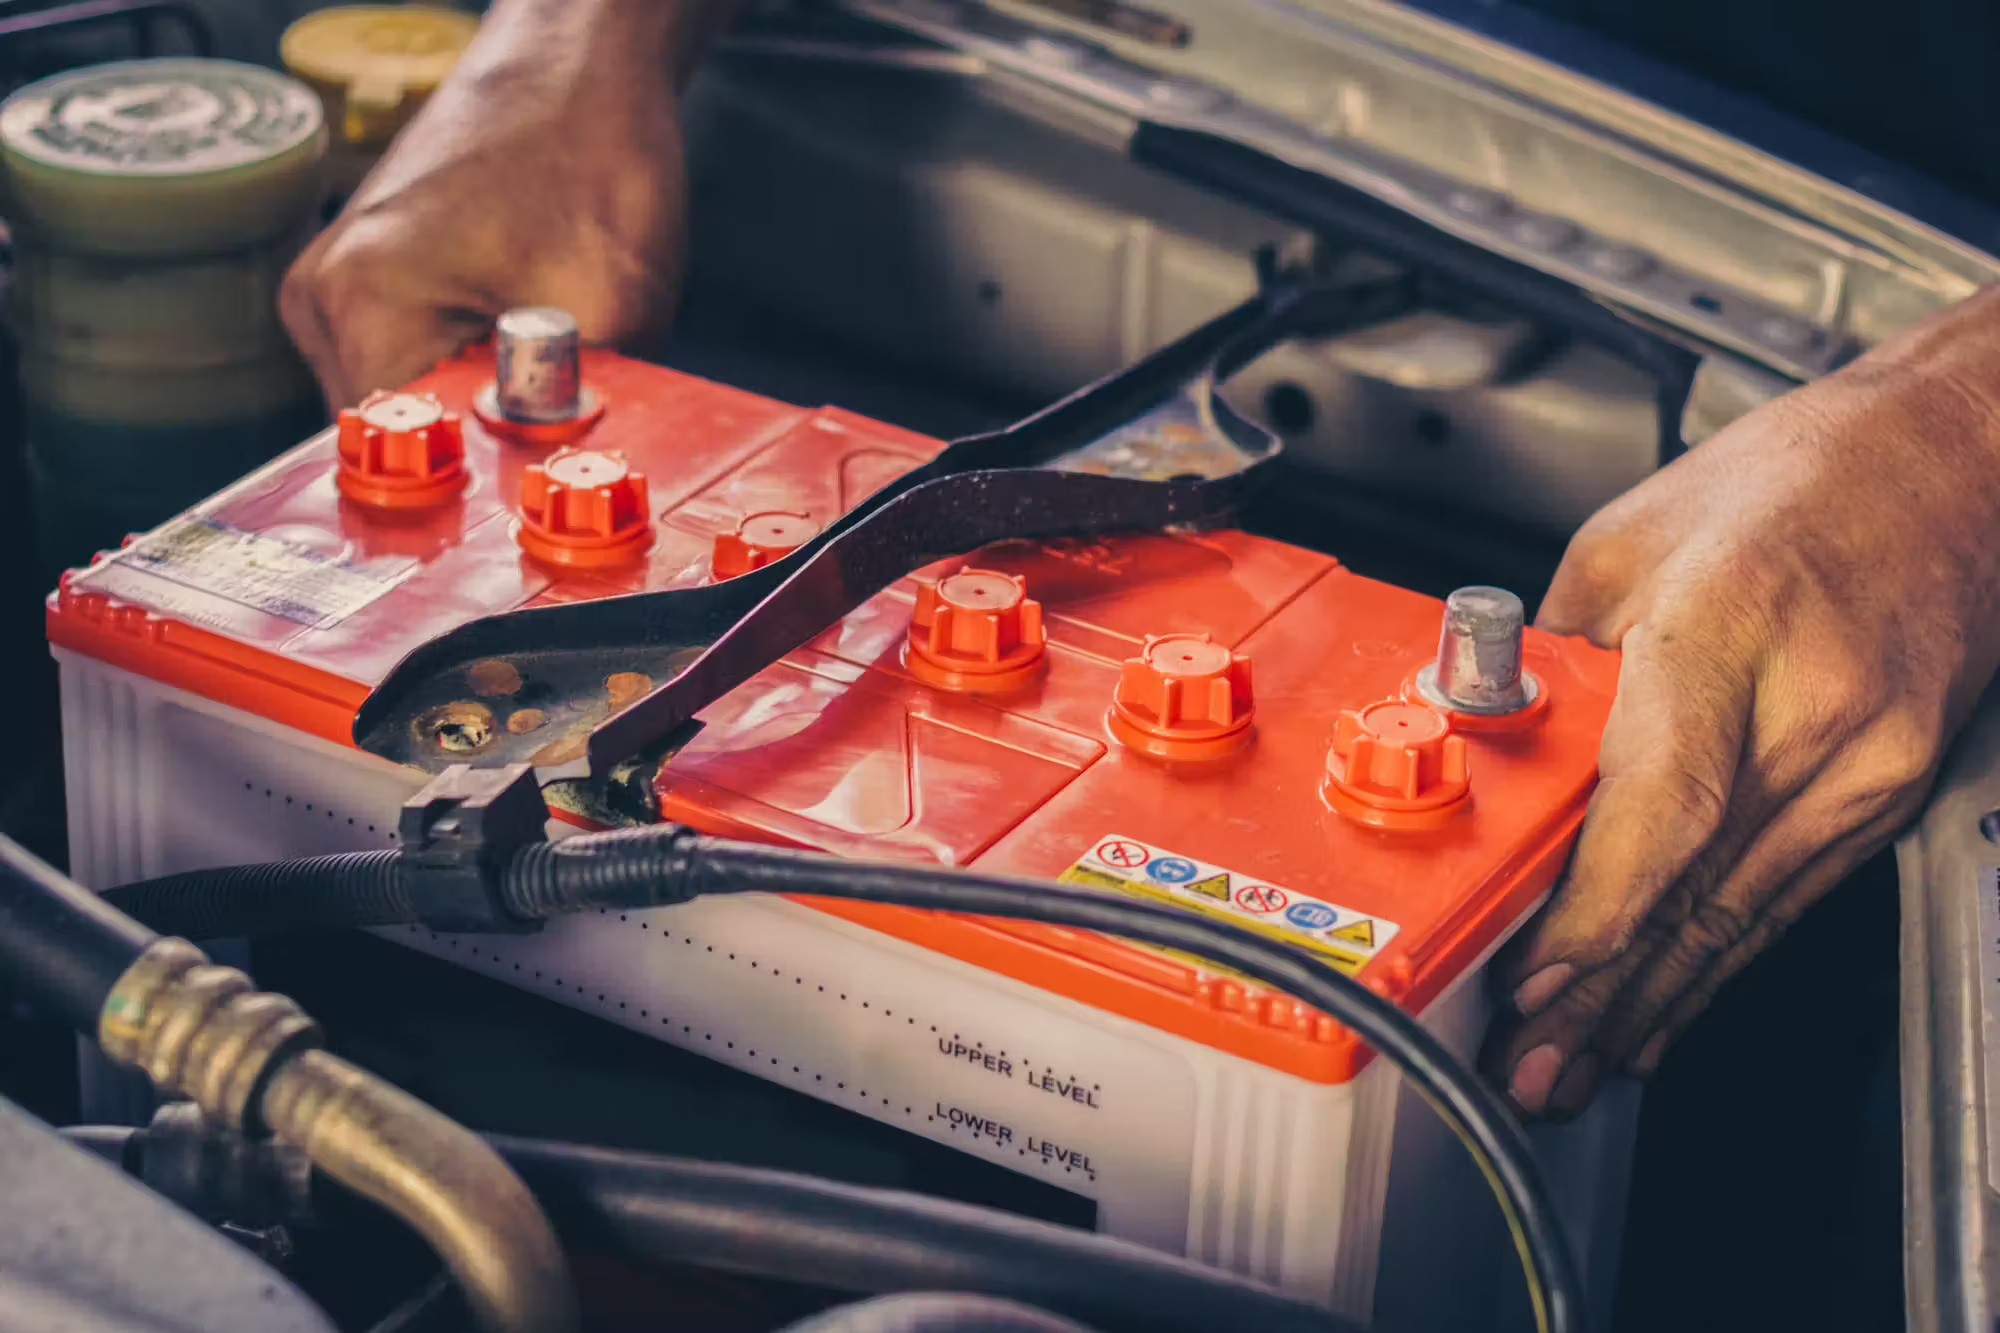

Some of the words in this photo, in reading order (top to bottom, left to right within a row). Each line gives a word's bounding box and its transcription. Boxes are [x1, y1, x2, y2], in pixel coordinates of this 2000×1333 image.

[938, 1037, 1012, 1078] UPPER
[1028, 1071, 1100, 1109] LEVEL
[936, 1102, 1013, 1143] LOWER
[1027, 1137, 1096, 1174] LEVEL
